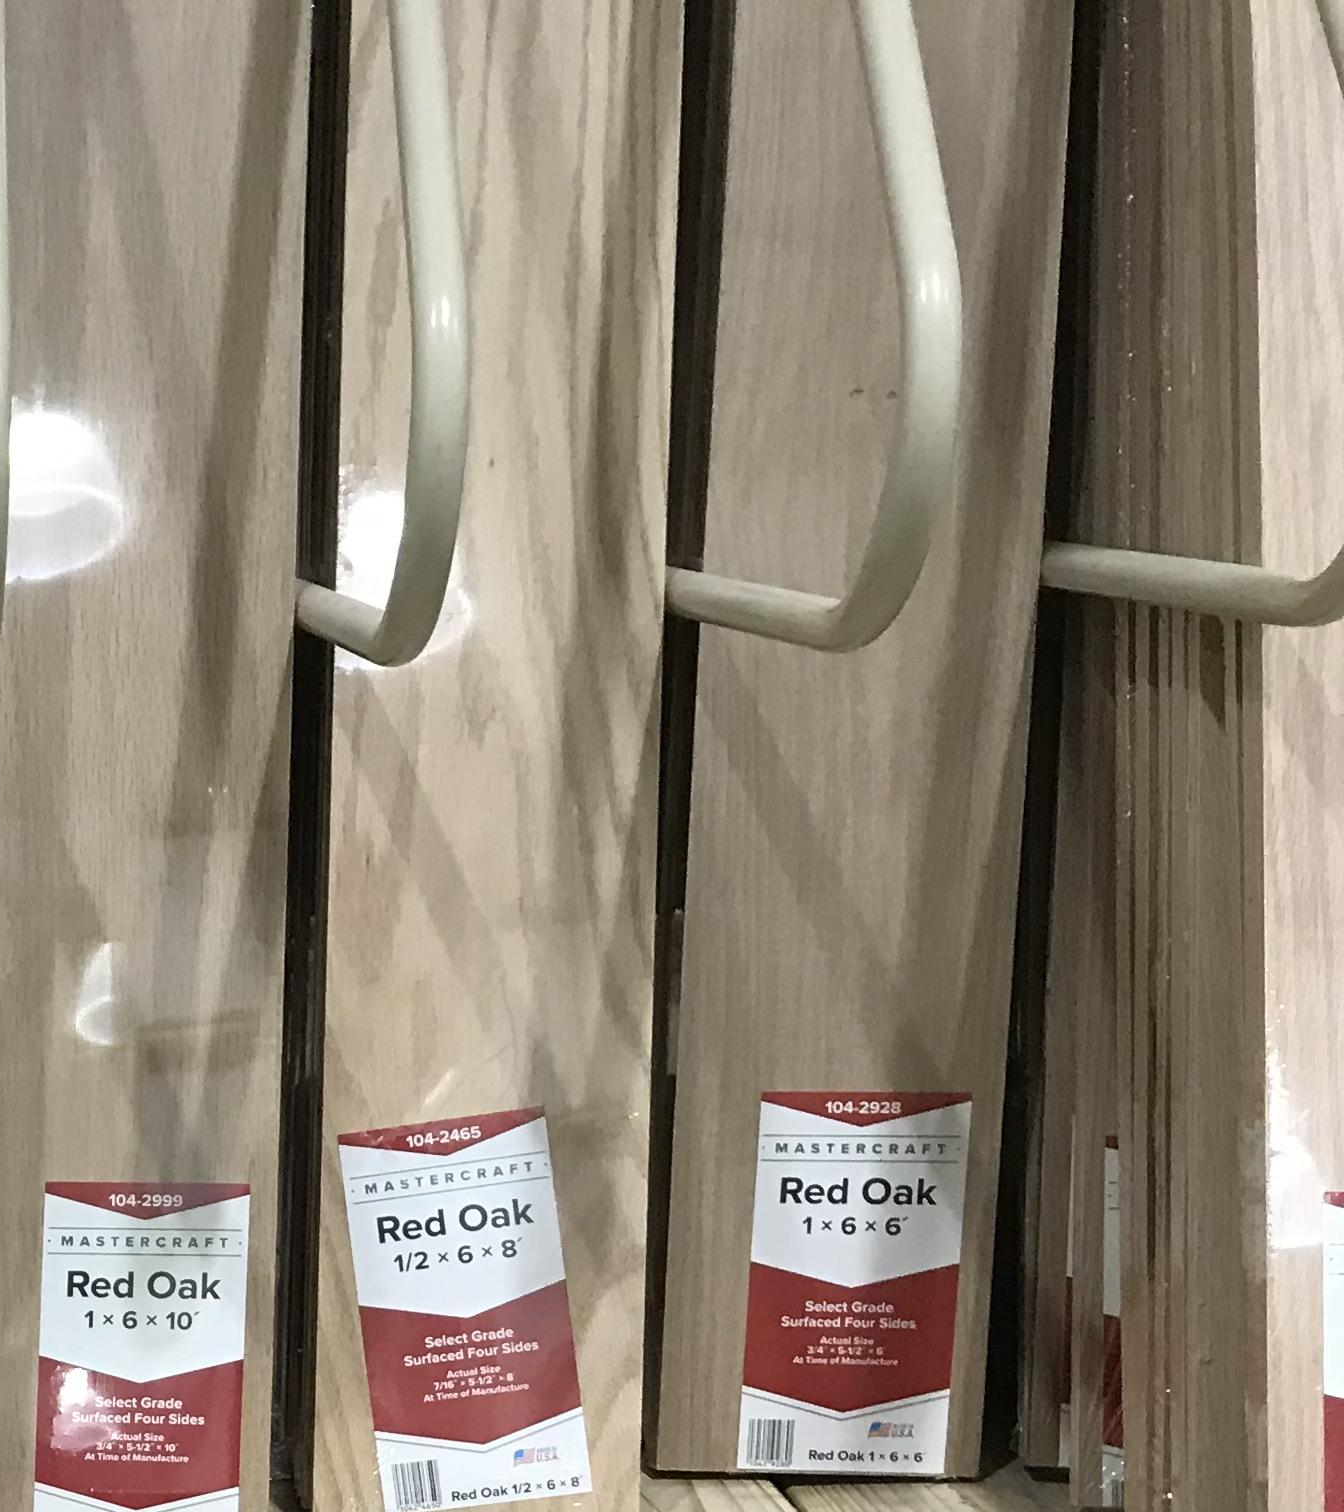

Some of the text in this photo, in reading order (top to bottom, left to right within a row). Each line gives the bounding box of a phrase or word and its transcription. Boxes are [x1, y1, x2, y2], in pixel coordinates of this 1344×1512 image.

[825, 1101, 900, 1115] 104-2928
[406, 1126, 481, 1148] 104-2465
[775, 1143, 947, 1155] MASTERCRAFT
[364, 1160, 534, 1195] MASTERCRAFT
[780, 1177, 937, 1206] Red Oak
[109, 1194, 183, 1207] 104-2999
[376, 1199, 534, 1244] Red Oak
[61, 1236, 230, 1248] MASTERCRAFT
[67, 1270, 221, 1300] Red Oak
[805, 1301, 894, 1313] Select Grade
[781, 1317, 916, 1329] Surfaced Four Sides
[424, 1327, 514, 1349] Select Grade
[404, 1340, 539, 1368] Surfaced Four Sides
[95, 1397, 182, 1409] Select Grade
[72, 1412, 205, 1425] Surfaced Four Sides
